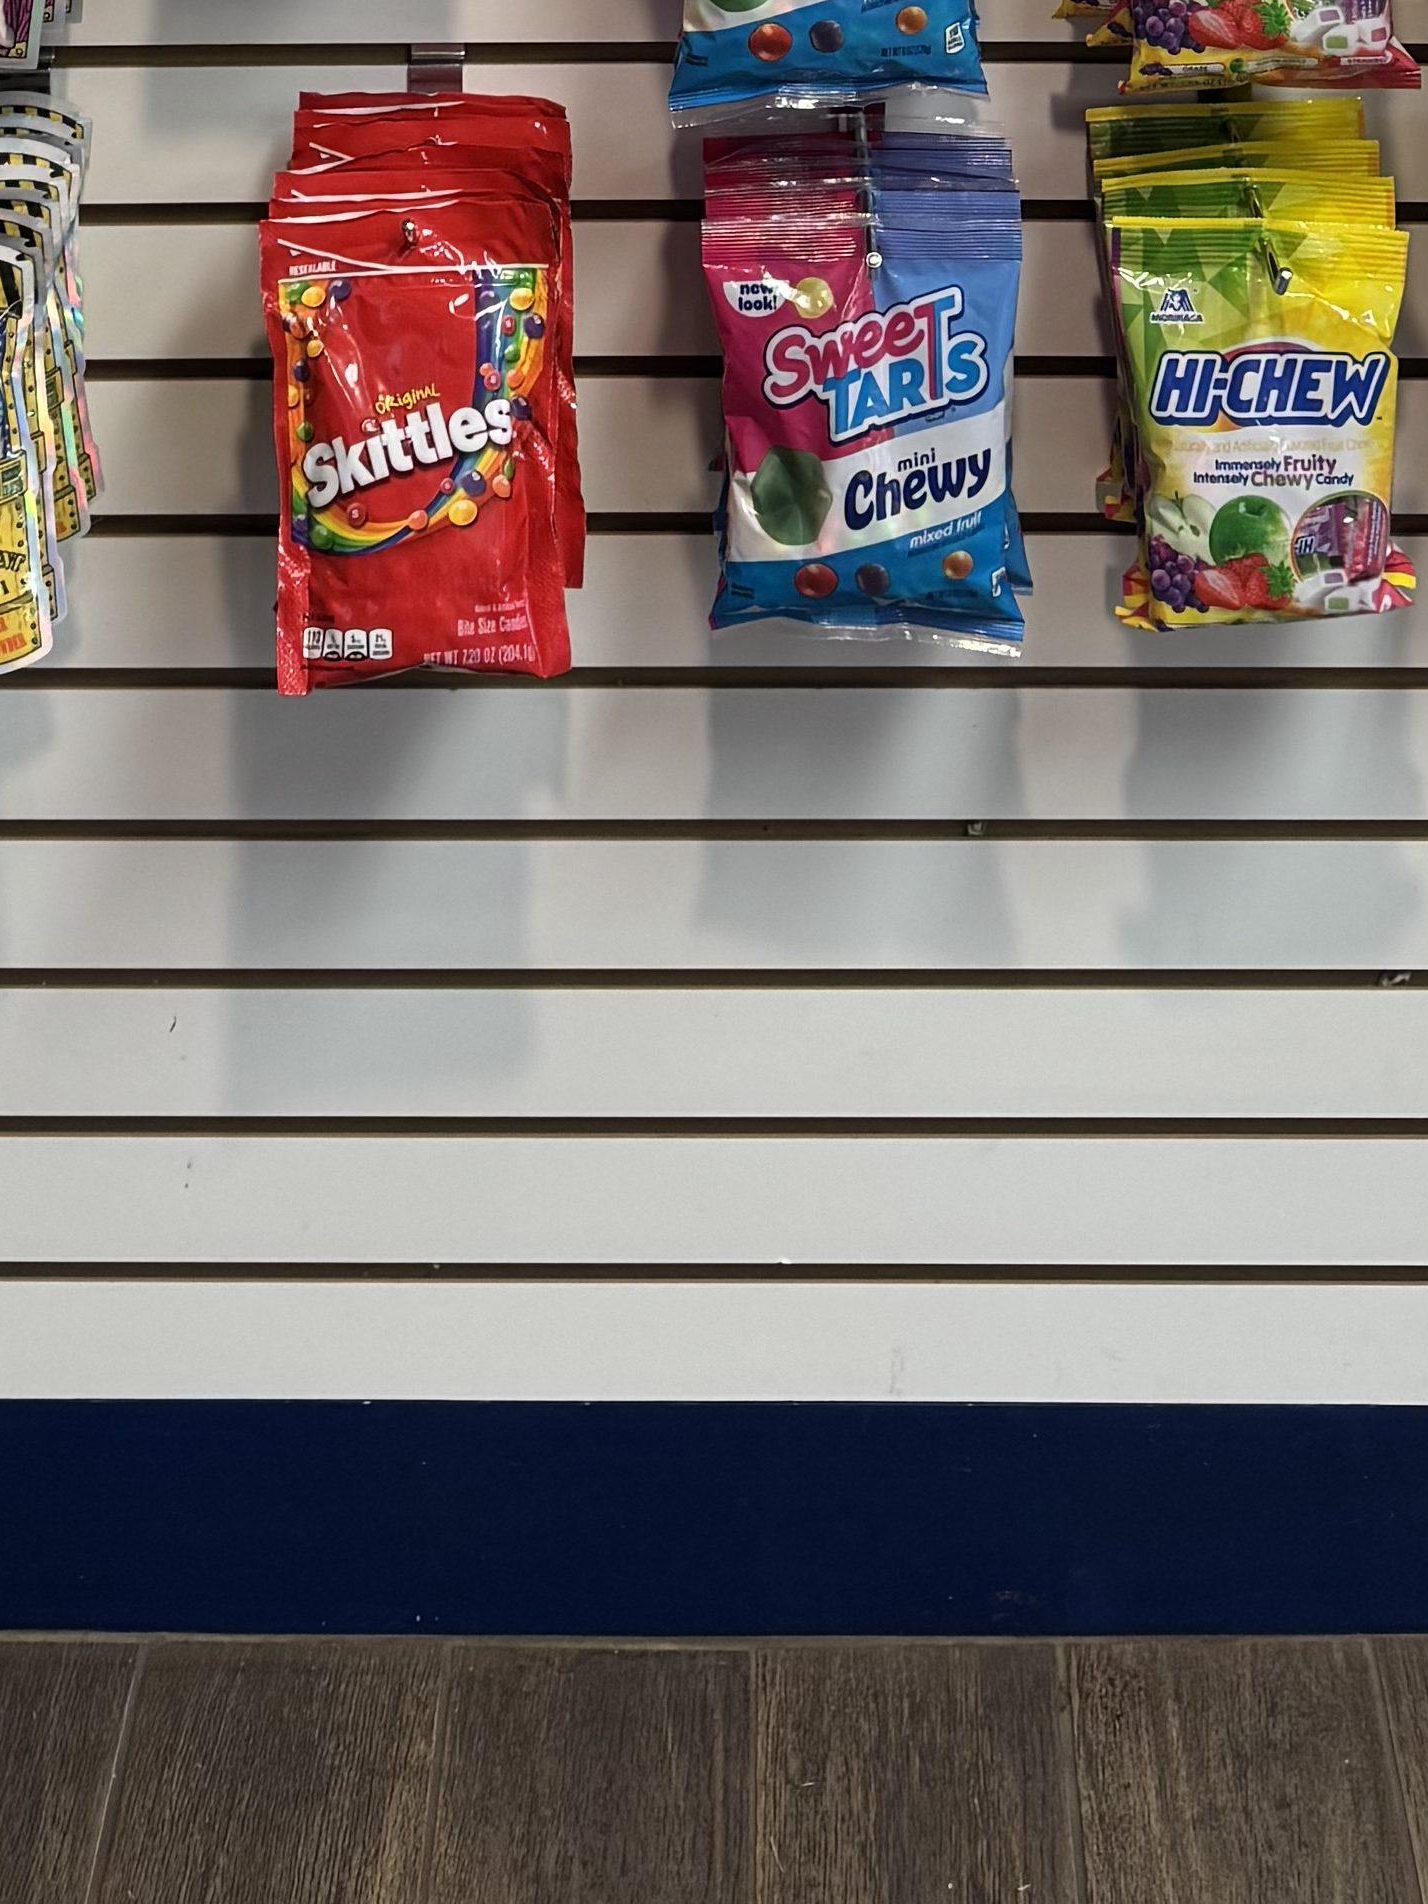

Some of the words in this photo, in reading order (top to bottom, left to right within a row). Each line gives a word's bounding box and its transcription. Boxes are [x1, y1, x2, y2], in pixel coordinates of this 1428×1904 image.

[1152, 353, 1387, 420] HI-CHEW
[304, 396, 513, 511] Skittles
[1193, 471, 1250, 487] Intensely
[1250, 470, 1315, 492] Chewy
[1315, 470, 1355, 488] Candy
[1214, 457, 1283, 475] Immensely
[1283, 454, 1337, 476] Fruity
[843, 448, 992, 533] Chewy
